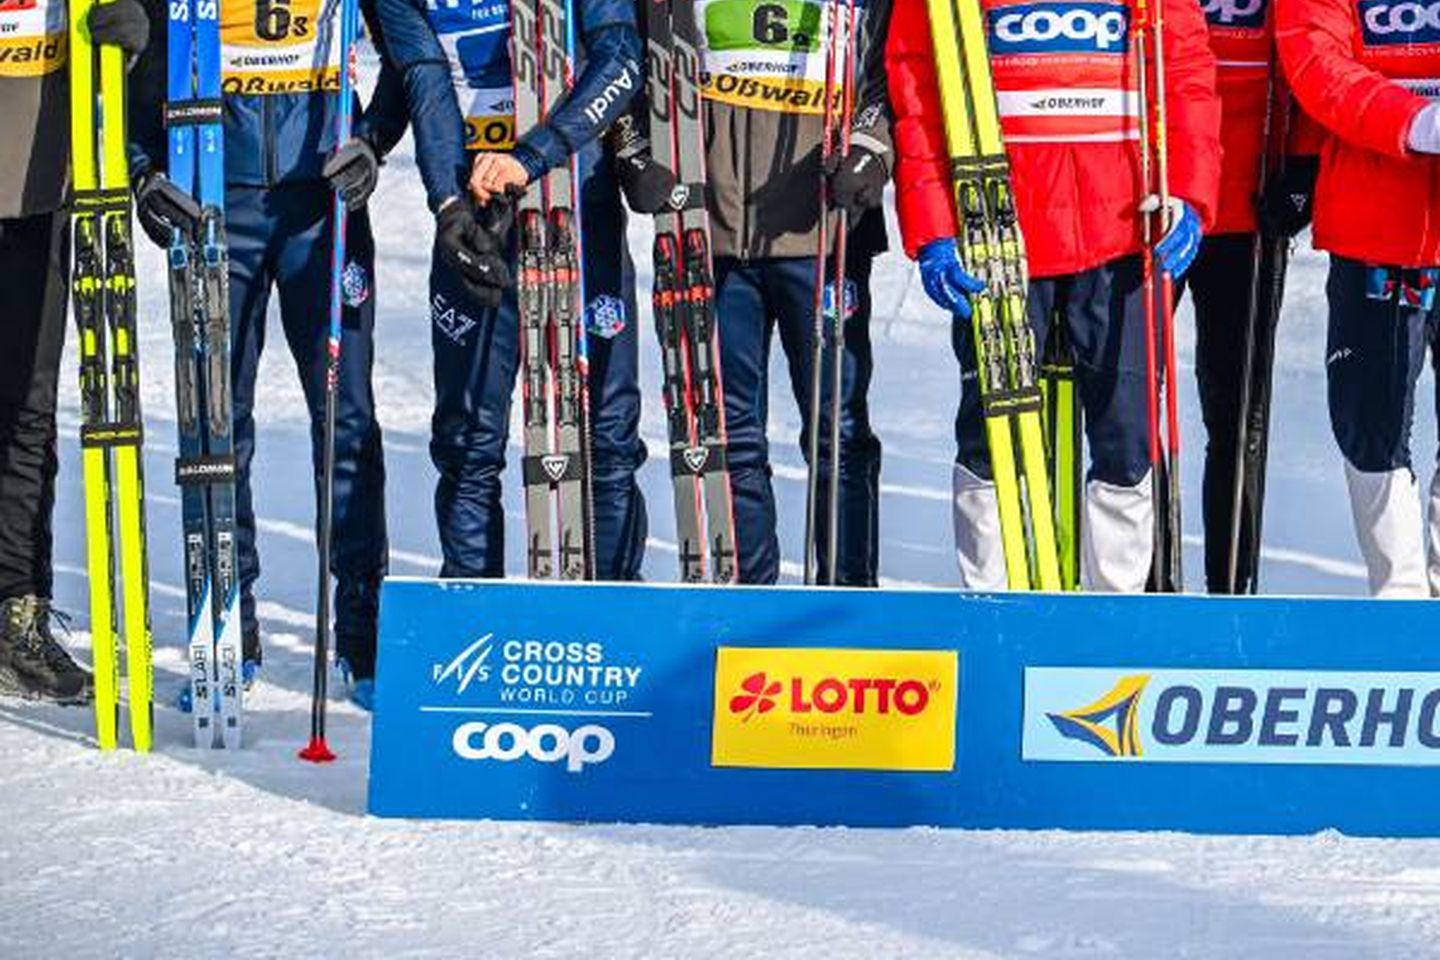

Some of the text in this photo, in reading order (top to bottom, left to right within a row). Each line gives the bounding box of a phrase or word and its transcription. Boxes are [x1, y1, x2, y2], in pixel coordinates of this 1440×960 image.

[995, 8, 1128, 49] coop
[584, 67, 634, 125] Audi
[502, 640, 604, 664] CROSS
[501, 664, 642, 688] COUNTRY
[500, 688, 628, 704] WORLD CUP
[790, 678, 929, 715] LOTTO
[453, 721, 616, 773] coop
